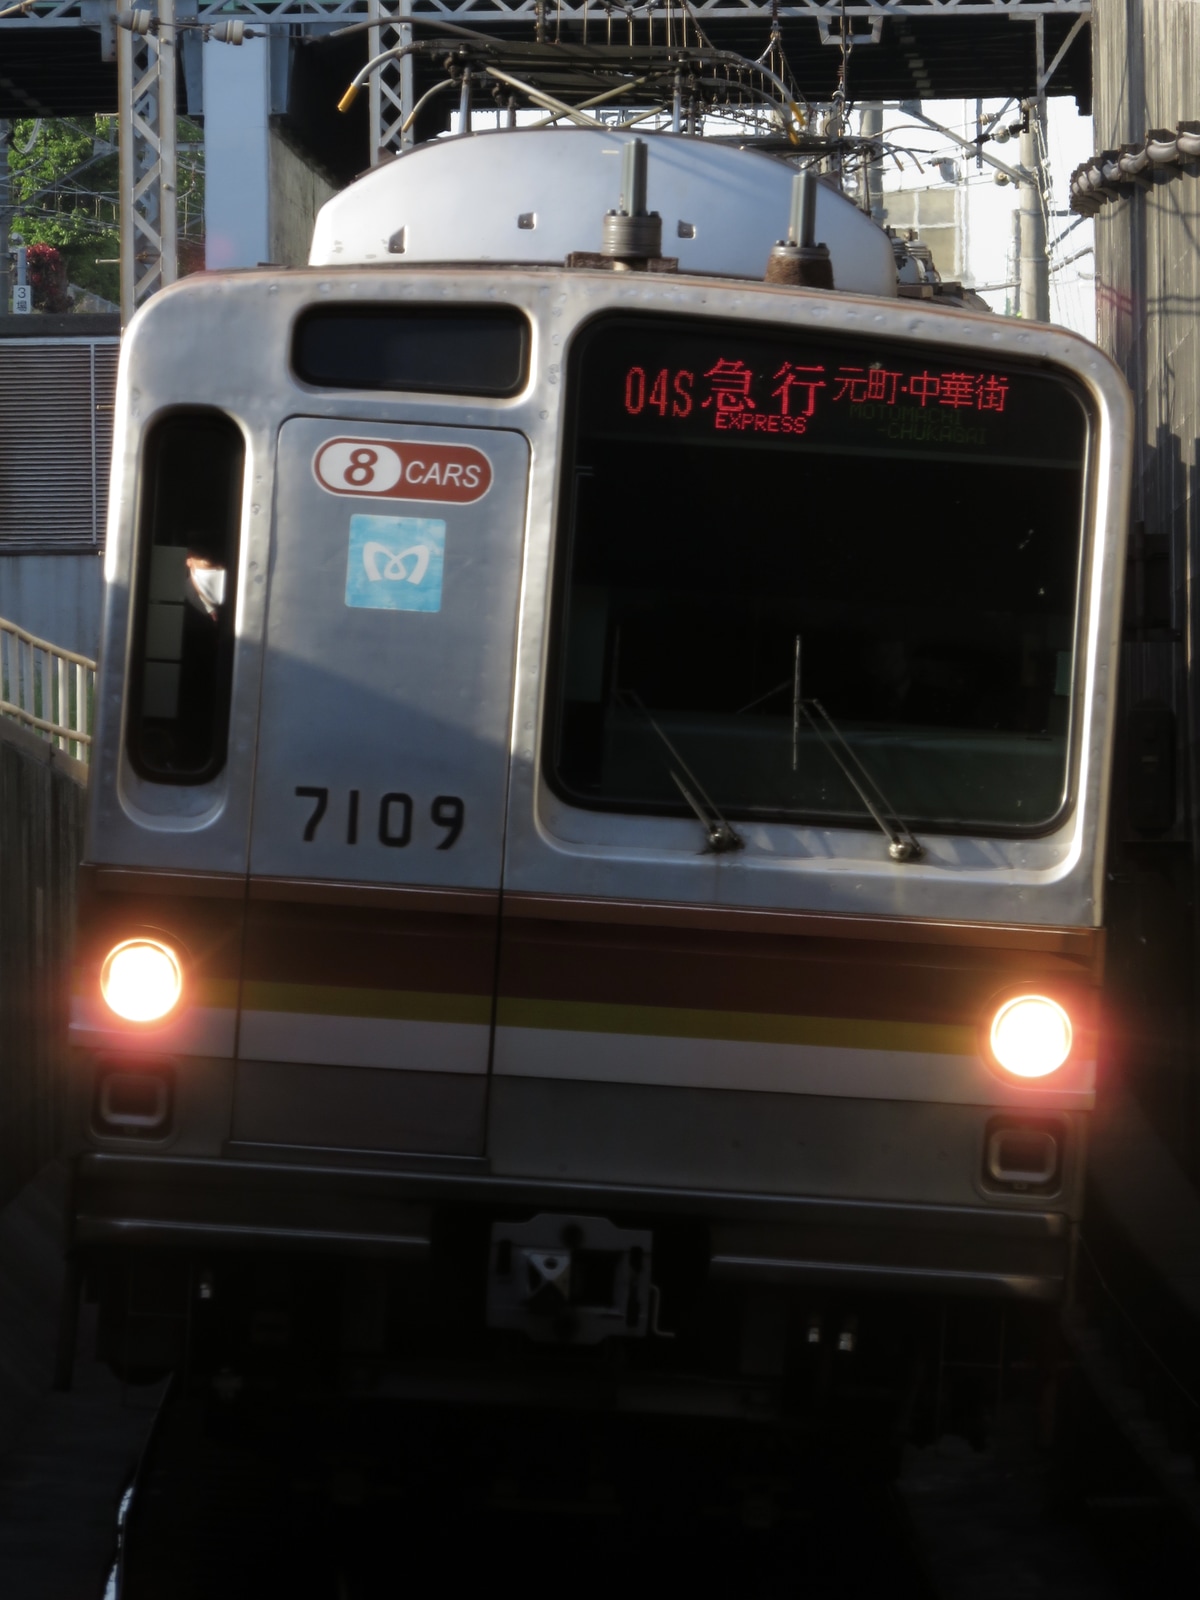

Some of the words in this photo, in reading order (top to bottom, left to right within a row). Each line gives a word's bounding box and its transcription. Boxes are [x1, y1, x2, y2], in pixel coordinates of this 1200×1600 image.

[625, 366, 695, 418] 04S
[701, 357, 827, 417] 急行
[714, 411, 808, 434] EXPRESS
[849, 403, 964, 426] MOTOMACHI
[343, 447, 379, 487] 8
[404, 460, 482, 488] CARS
[295, 785, 465, 850] 7109
